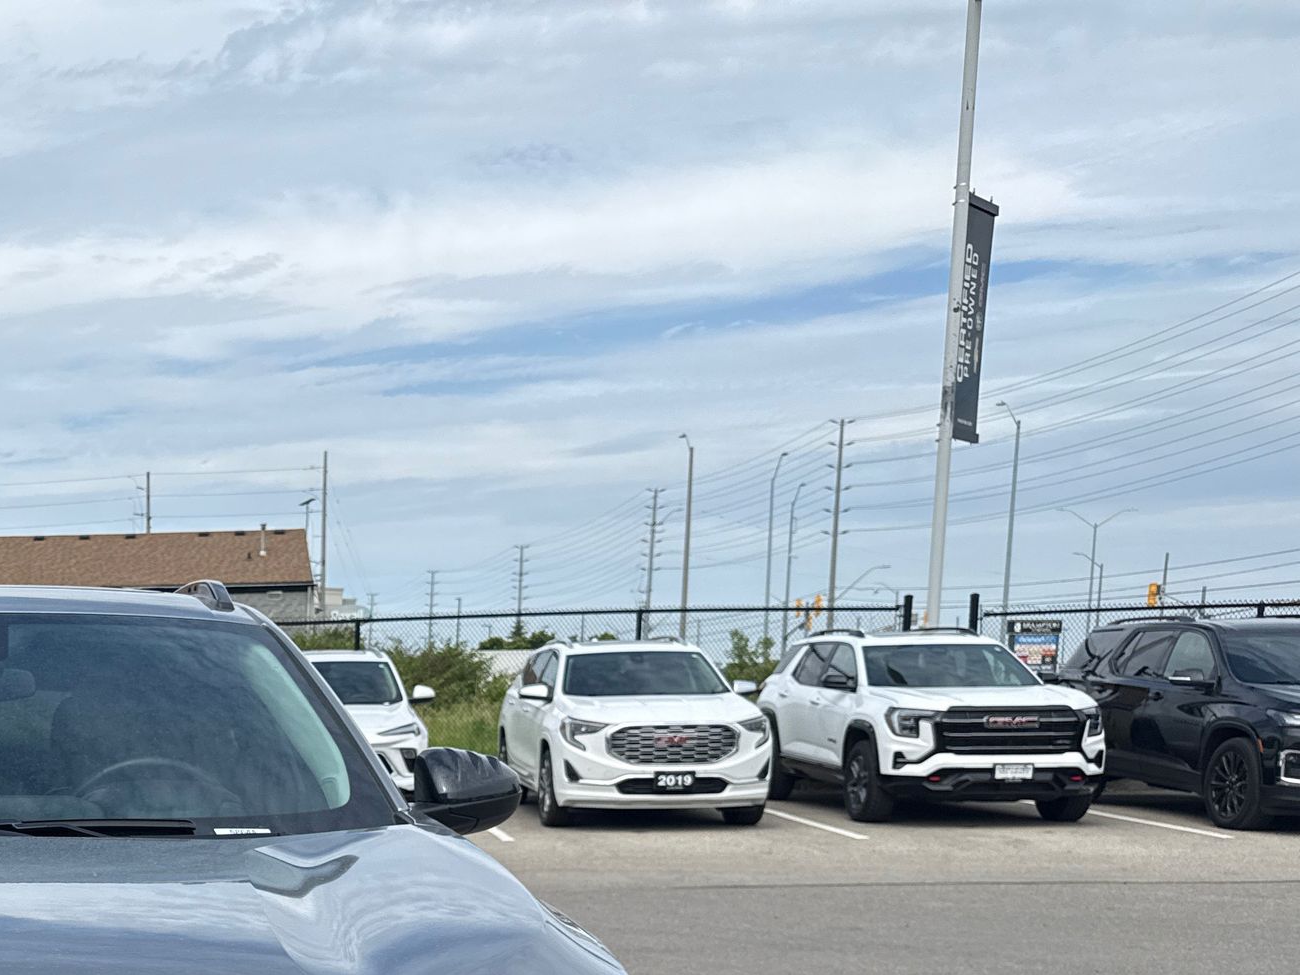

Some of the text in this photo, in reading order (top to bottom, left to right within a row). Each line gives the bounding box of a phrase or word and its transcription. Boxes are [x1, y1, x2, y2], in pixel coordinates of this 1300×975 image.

[956, 243, 974, 383] CERTIFIED
[963, 252, 979, 378] PRE-OWNED
[657, 774, 692, 786] 2019
